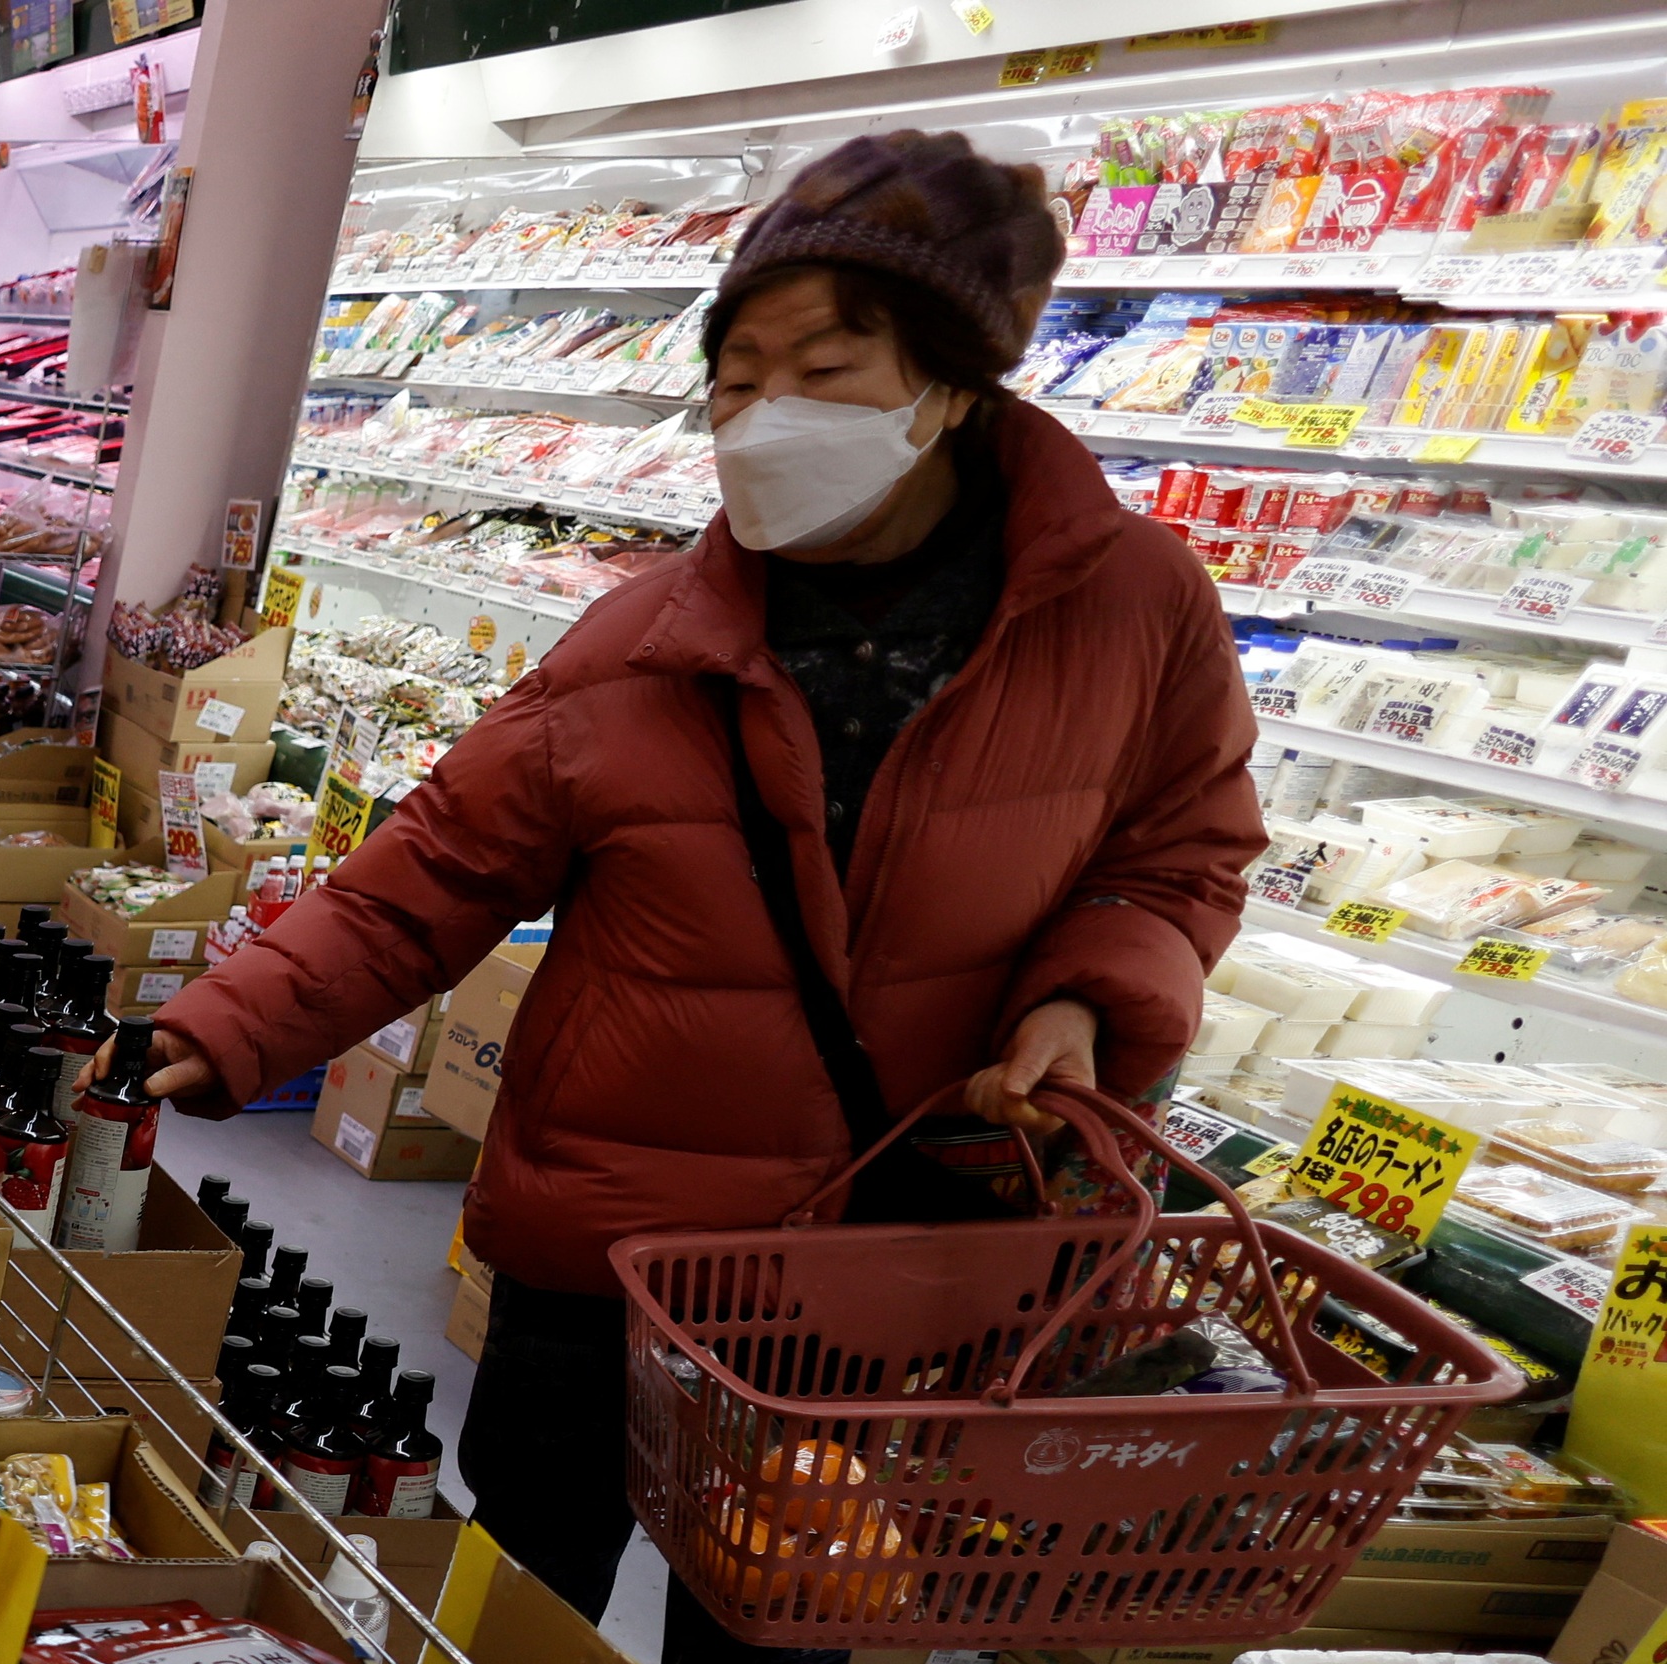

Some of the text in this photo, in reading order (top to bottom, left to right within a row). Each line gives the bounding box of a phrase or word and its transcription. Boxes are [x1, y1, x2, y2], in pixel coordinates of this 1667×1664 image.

[1301, 425, 1335, 438] 178
[1593, 438, 1629, 454] 118
[1299, 579, 1334, 592] 100
[1355, 590, 1390, 605] 100
[1517, 599, 1554, 614] 138
[1387, 718, 1420, 738] 178
[168, 829, 198, 856] 208
[321, 823, 352, 856] 120
[1261, 885, 1289, 903] 128
[1336, 907, 1394, 926] 生揚げ
[1339, 920, 1372, 936] 138
[1475, 960, 1512, 975] 138
[447, 1028, 478, 1052] クロレラ
[1167, 1127, 1202, 1148] 238
[1348, 1103, 1447, 1152] 当店大人気
[1317, 1115, 1445, 1197] 名店のラーメン
[1328, 1170, 1414, 1232] 298
[1554, 1283, 1599, 1309] 198
[1601, 1307, 1663, 1337] 1パック
[1592, 1353, 1650, 1371] アキダイ
[1080, 1440, 1200, 1470] アキダイ
